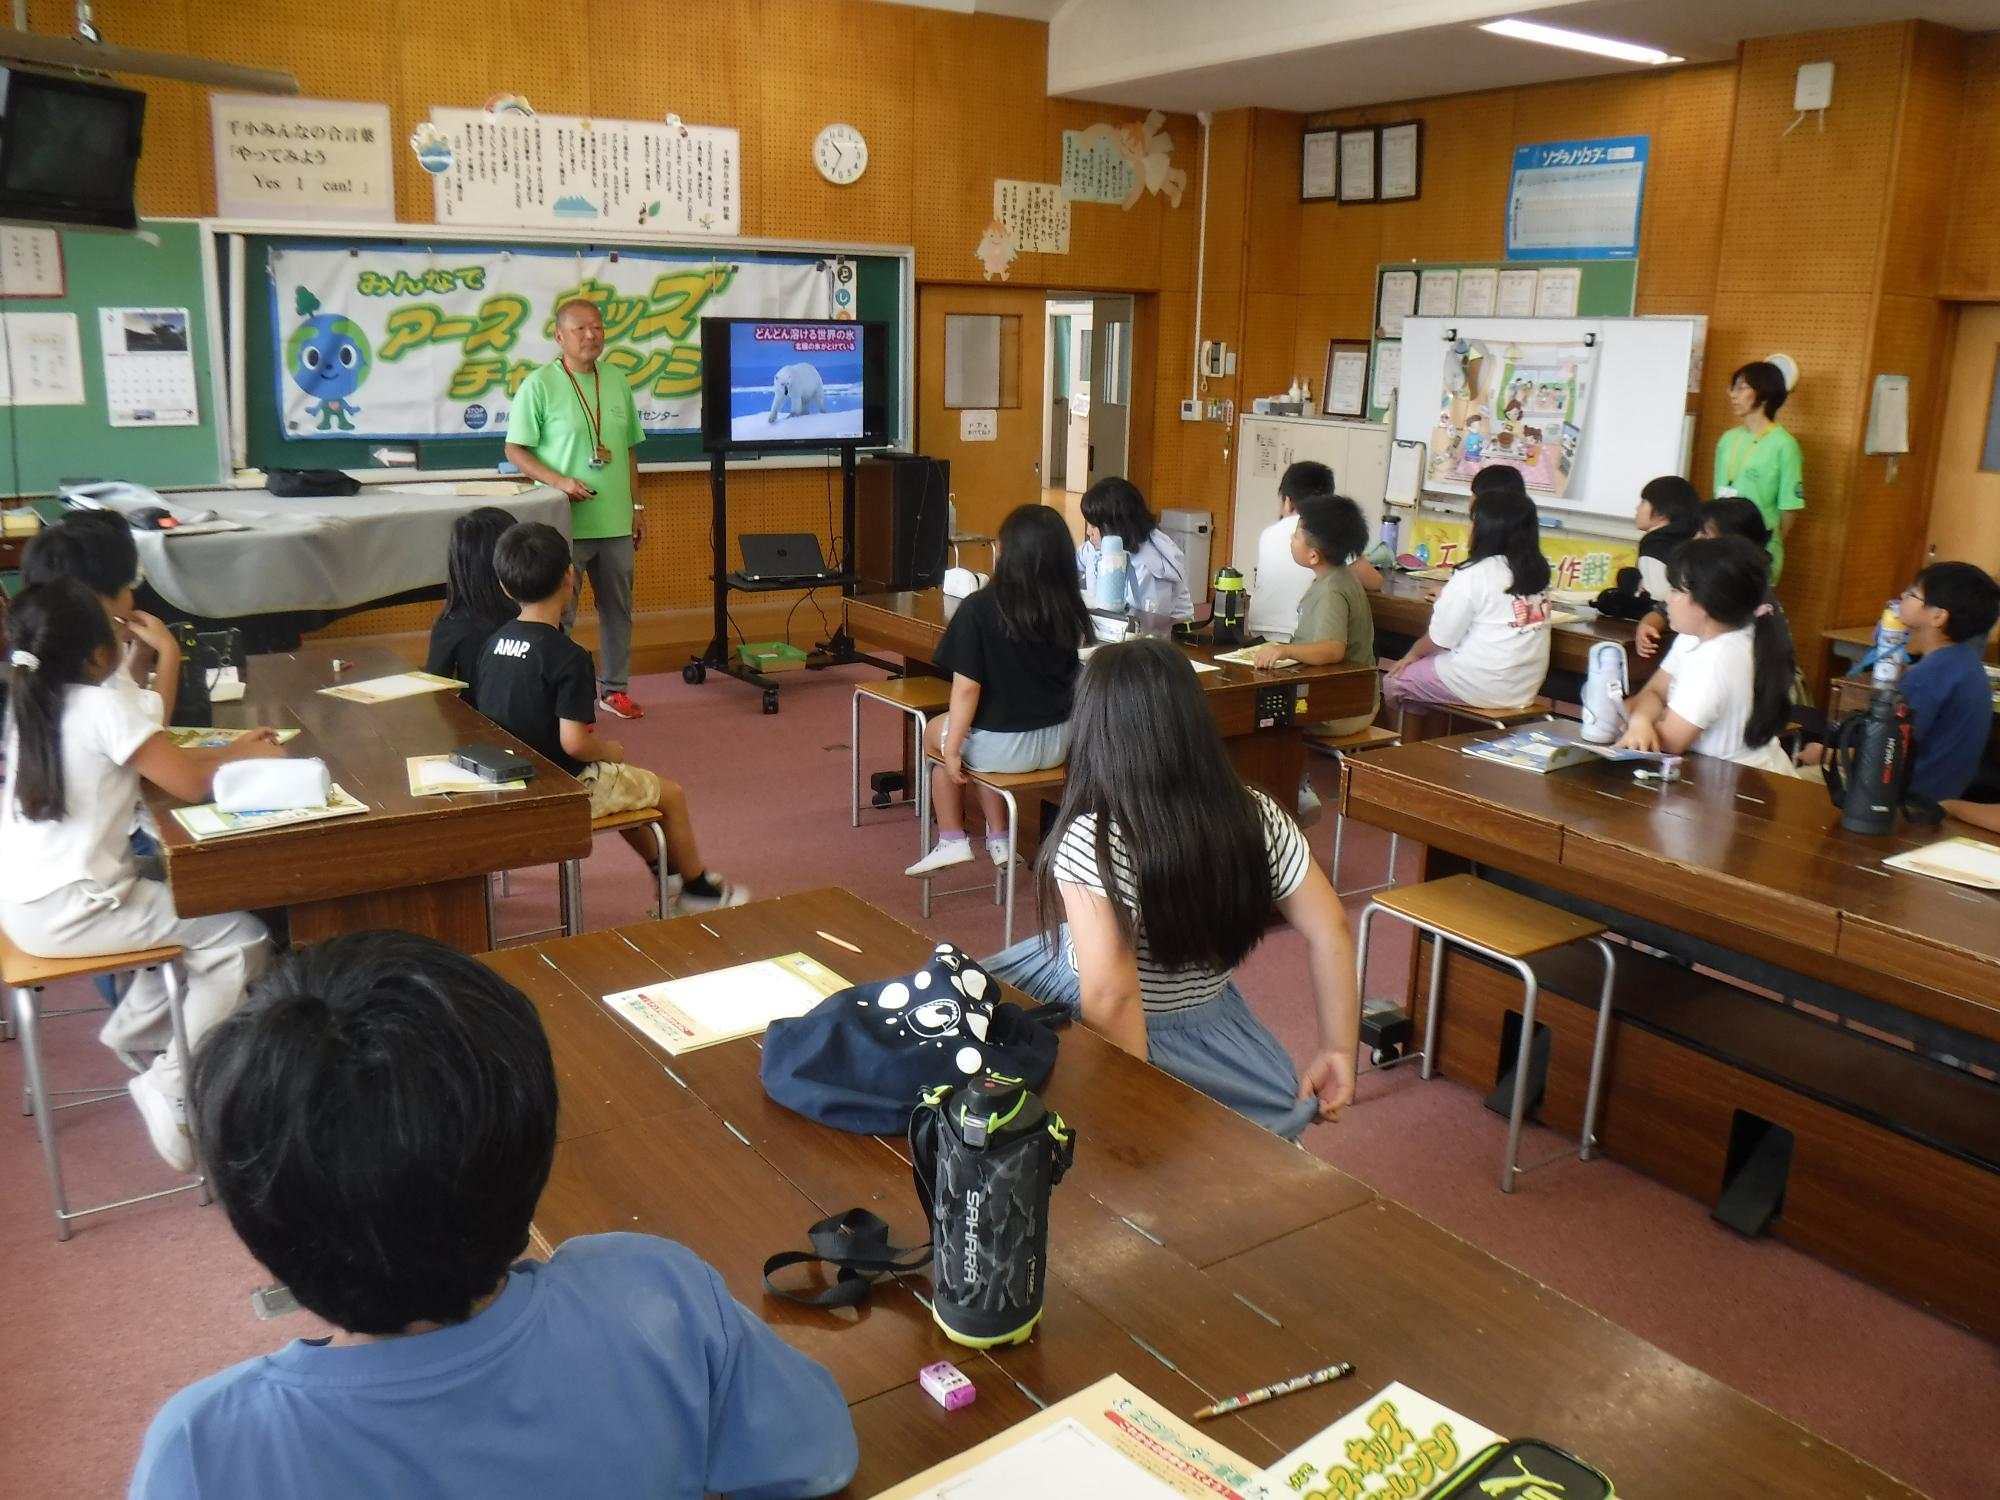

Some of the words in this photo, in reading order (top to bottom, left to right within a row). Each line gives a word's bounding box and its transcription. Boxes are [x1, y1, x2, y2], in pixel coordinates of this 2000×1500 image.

[253, 174, 281, 190] Yes
[322, 179, 352, 193] can!
[356, 264, 487, 297] みんなで
[377, 291, 531, 363] アース
[755, 328, 855, 341] どんどん溶ける世界の氷
[963, 1189, 981, 1284] SAHARA
